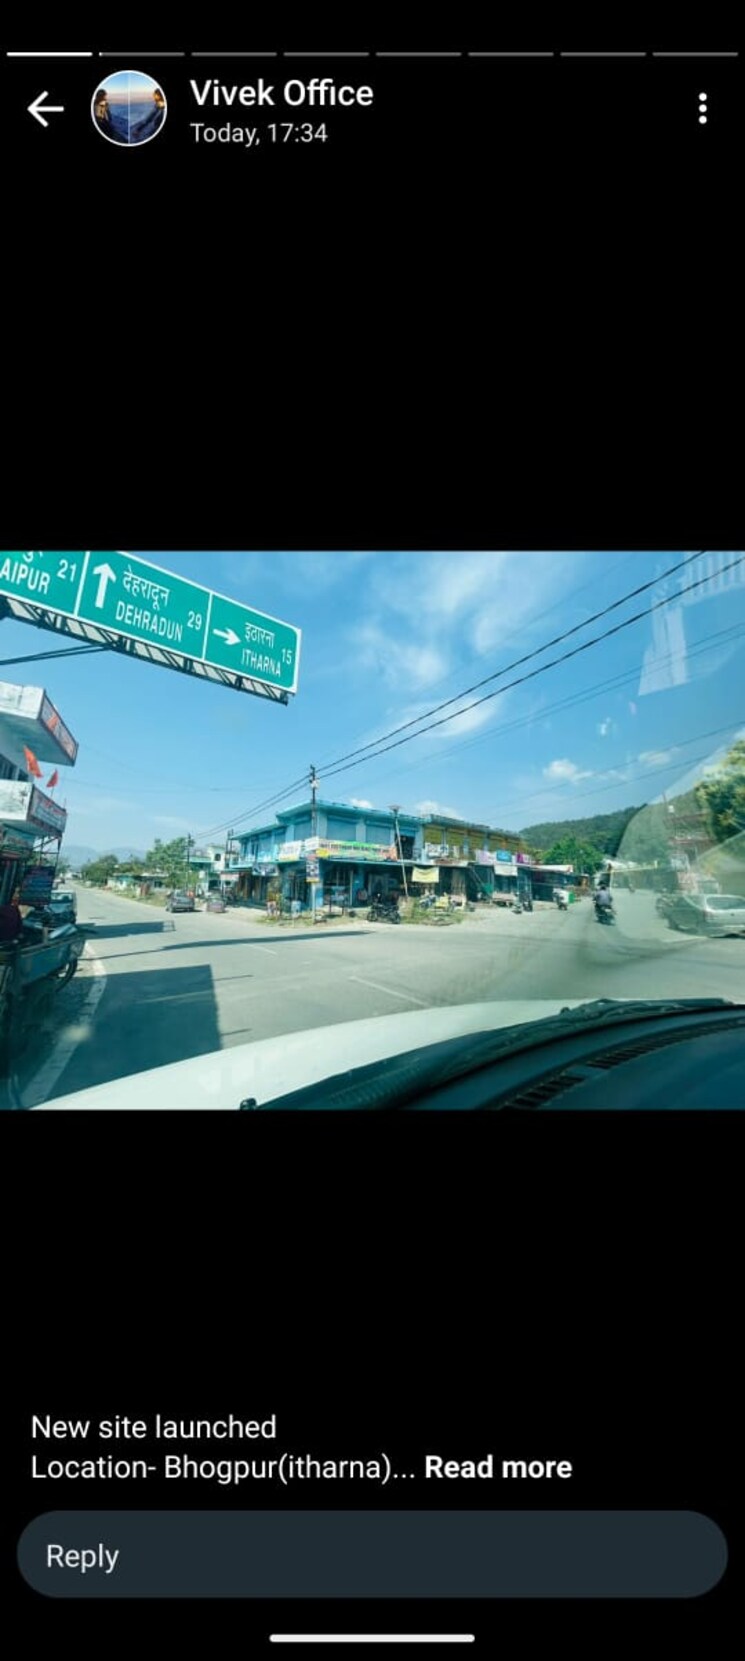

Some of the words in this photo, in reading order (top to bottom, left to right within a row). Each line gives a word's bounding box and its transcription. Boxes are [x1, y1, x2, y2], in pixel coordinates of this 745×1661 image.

[57, 559, 76, 582] 21
[122, 564, 170, 610] देहरादून
[115, 600, 183, 642] DEHRADUN
[187, 611, 202, 630] 29
[244, 622, 275, 649] इठारना
[241, 649, 281, 677] ITHARNA
[281, 649, 292, 665] 15
